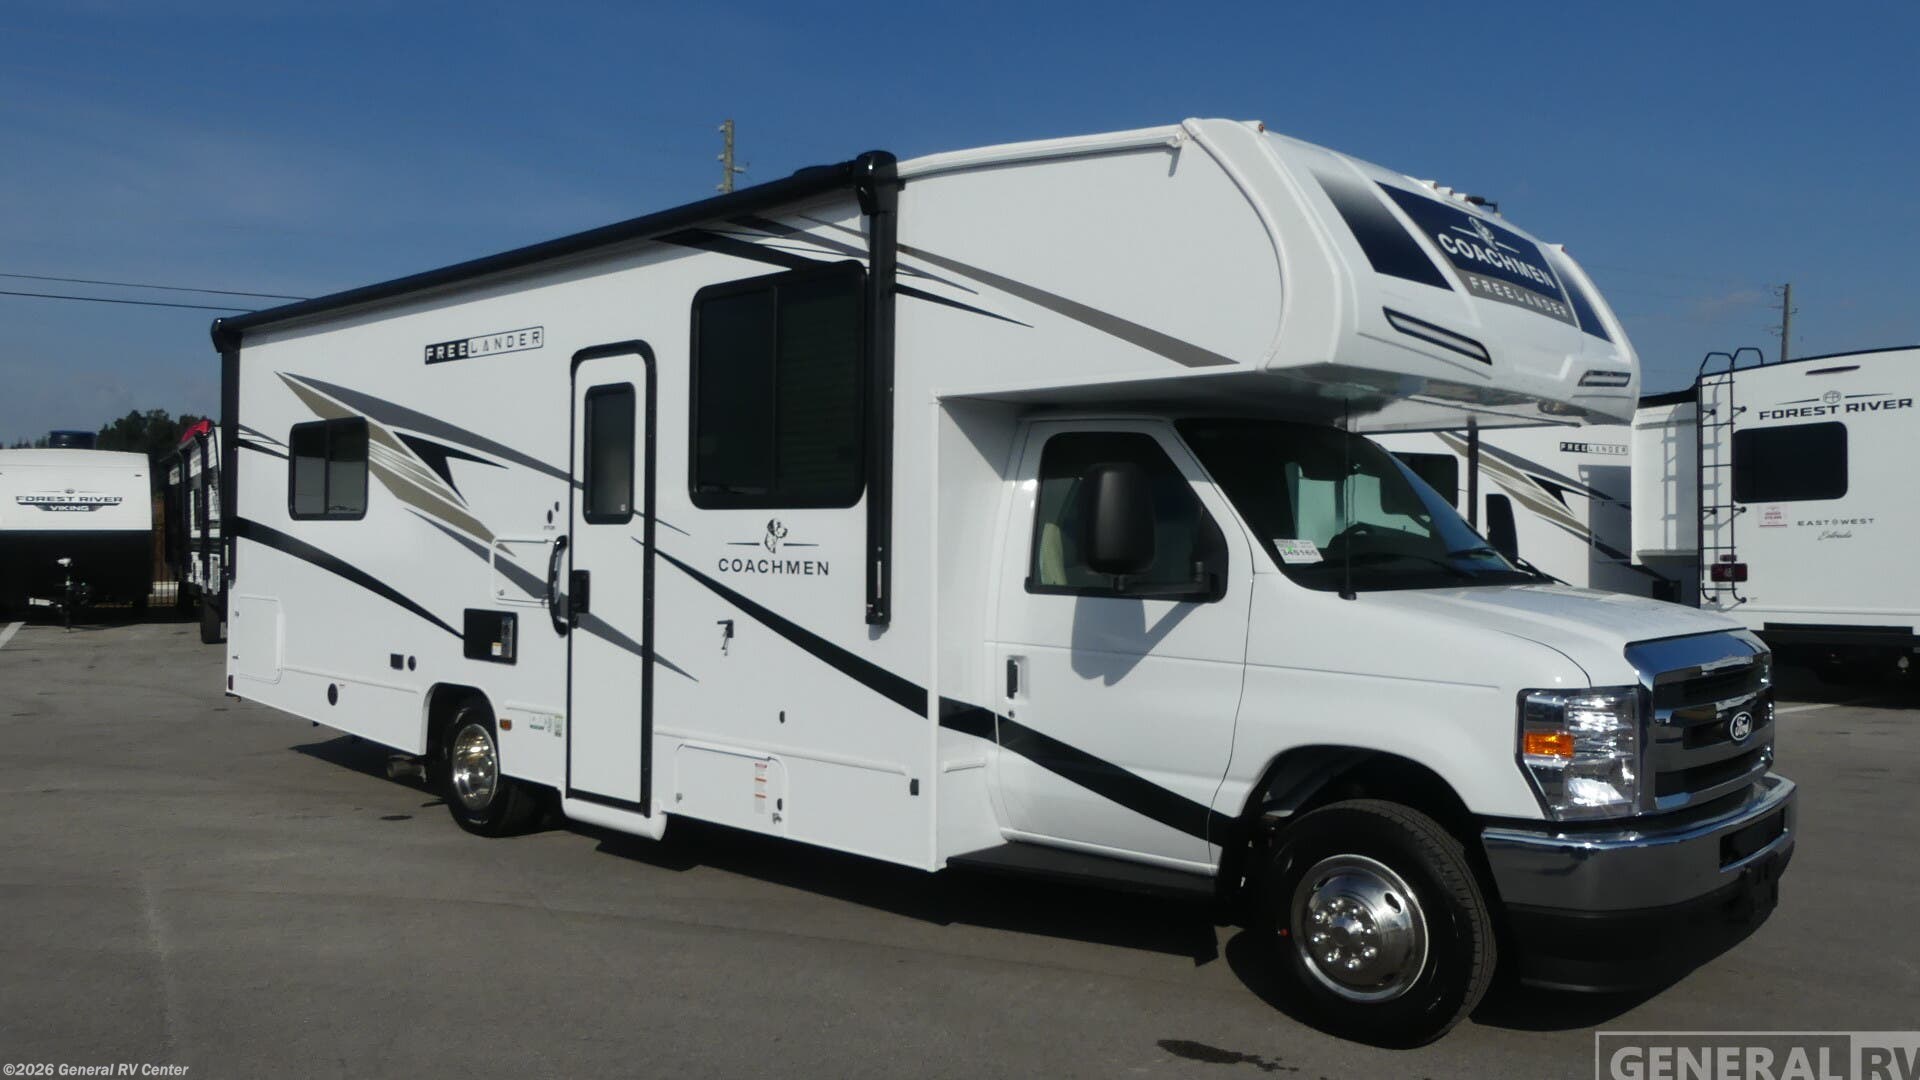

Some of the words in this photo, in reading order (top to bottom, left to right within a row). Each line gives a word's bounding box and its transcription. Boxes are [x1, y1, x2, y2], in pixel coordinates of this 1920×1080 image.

[1438, 233, 1556, 289] COACHMEN
[1469, 276, 1569, 319] FREELANDER
[426, 331, 541, 361] FREELANDER
[1759, 404, 1840, 420] FOREST
[1846, 398, 1913, 413] RIVER
[718, 558, 830, 576] COACHMEN
